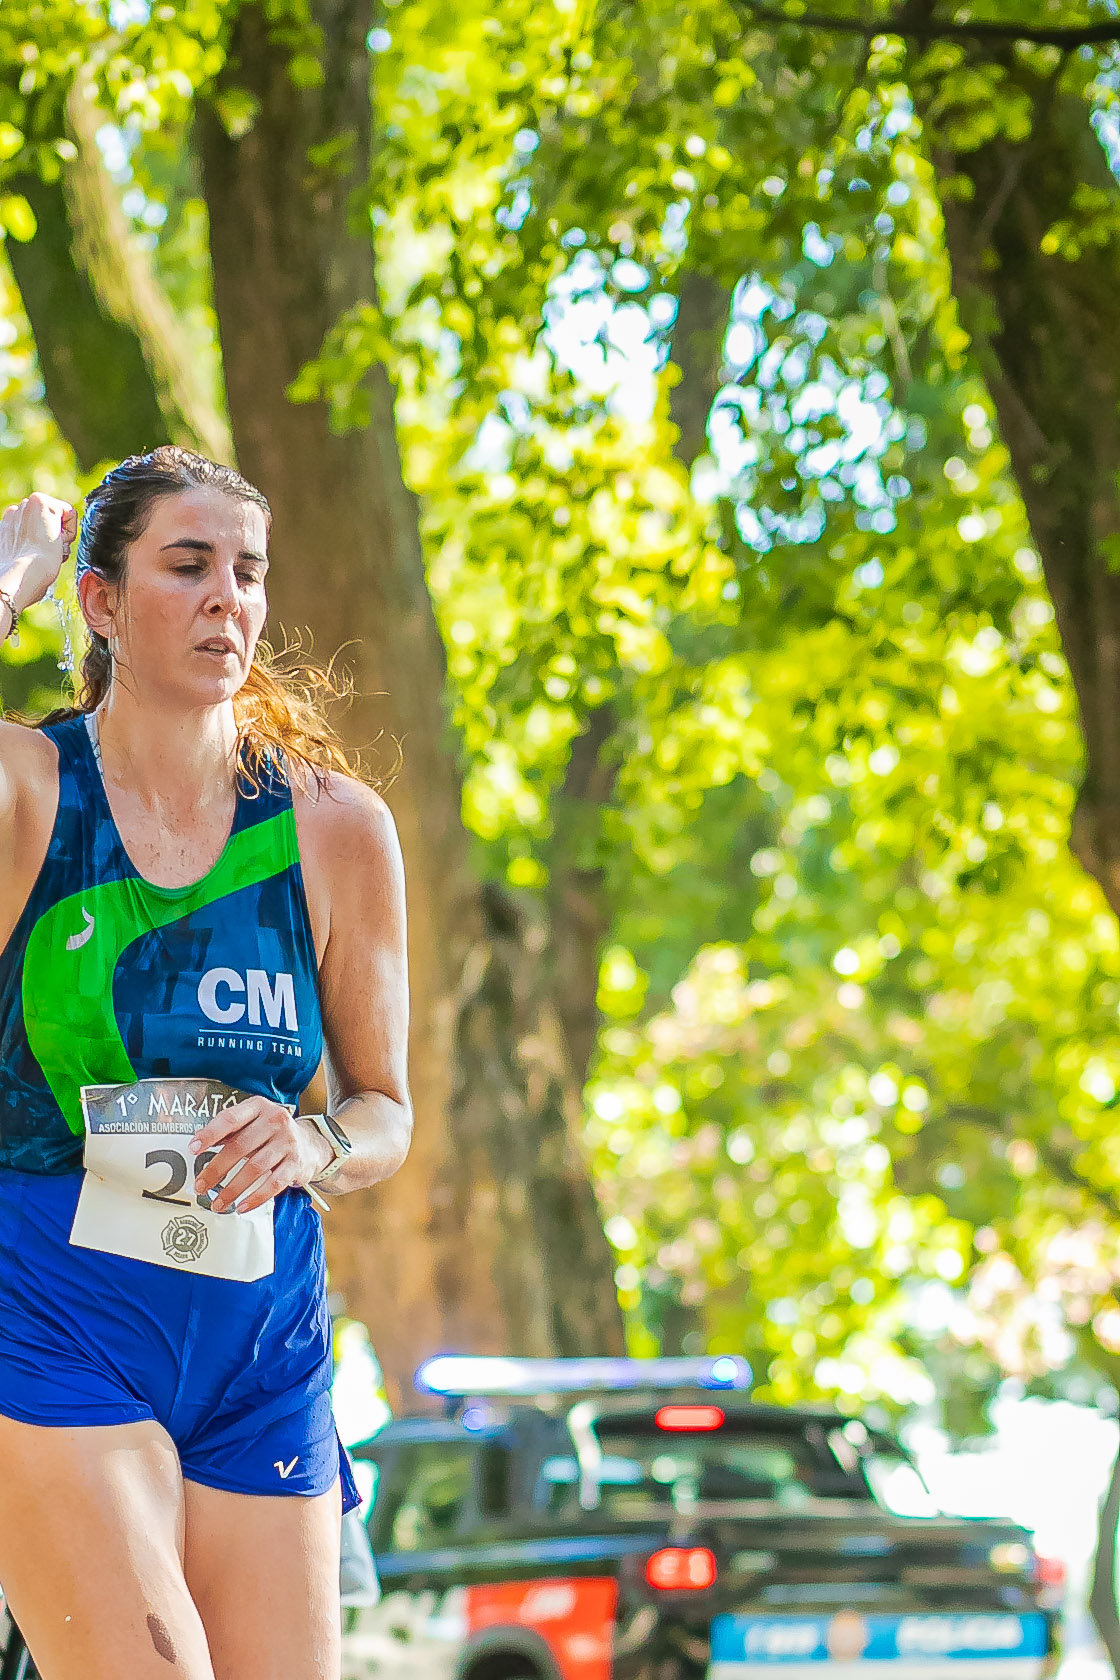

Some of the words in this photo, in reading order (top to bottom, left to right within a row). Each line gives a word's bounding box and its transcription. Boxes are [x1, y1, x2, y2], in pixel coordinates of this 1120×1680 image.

[197, 966, 299, 1032] CM
[197, 1036, 264, 1052] RUNNING
[271, 1042, 302, 1058] TEAM
[98, 1119, 150, 1134] ASOCIACIÓN
[151, 1121, 194, 1134] BOMBEROS
[175, 1228, 197, 1247] 27
